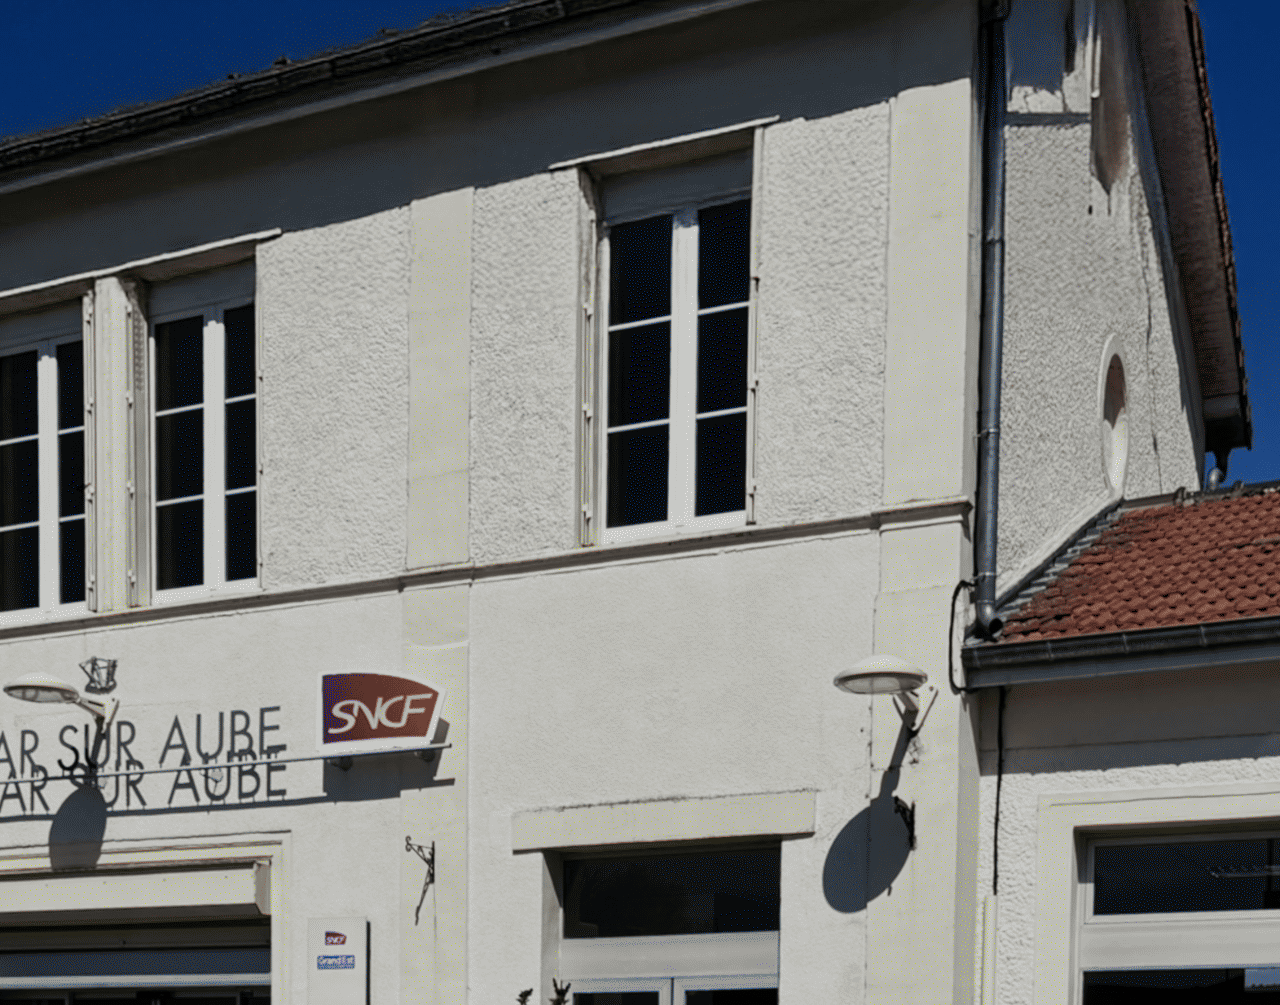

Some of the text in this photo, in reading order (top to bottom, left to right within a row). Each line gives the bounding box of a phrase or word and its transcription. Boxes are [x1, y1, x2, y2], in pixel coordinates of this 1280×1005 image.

[57, 720, 136, 773] SUR
[159, 705, 282, 767] AUBE
[328, 693, 434, 734] SNCF
